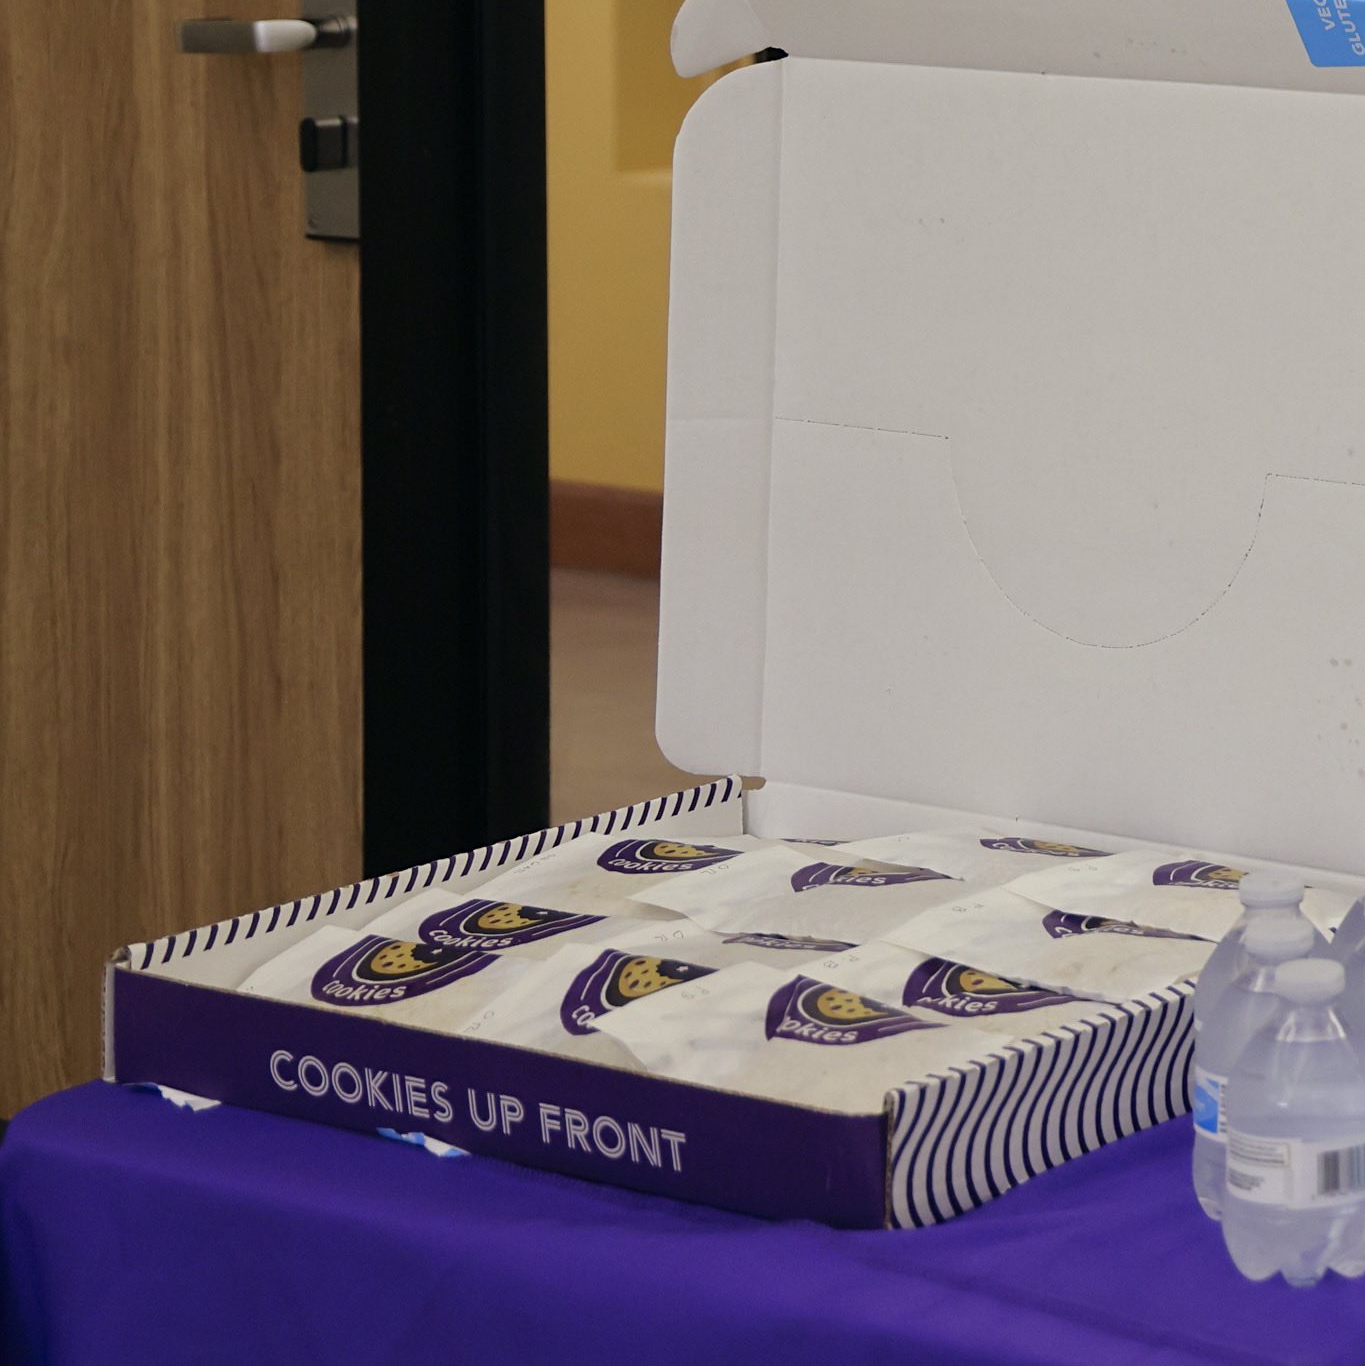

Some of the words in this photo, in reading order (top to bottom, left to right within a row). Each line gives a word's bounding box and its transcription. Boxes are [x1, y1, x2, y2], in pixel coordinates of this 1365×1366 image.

[269, 1049, 453, 1123] COOKIES
[467, 1087, 525, 1136] UP
[539, 1101, 686, 1173] FRONT
